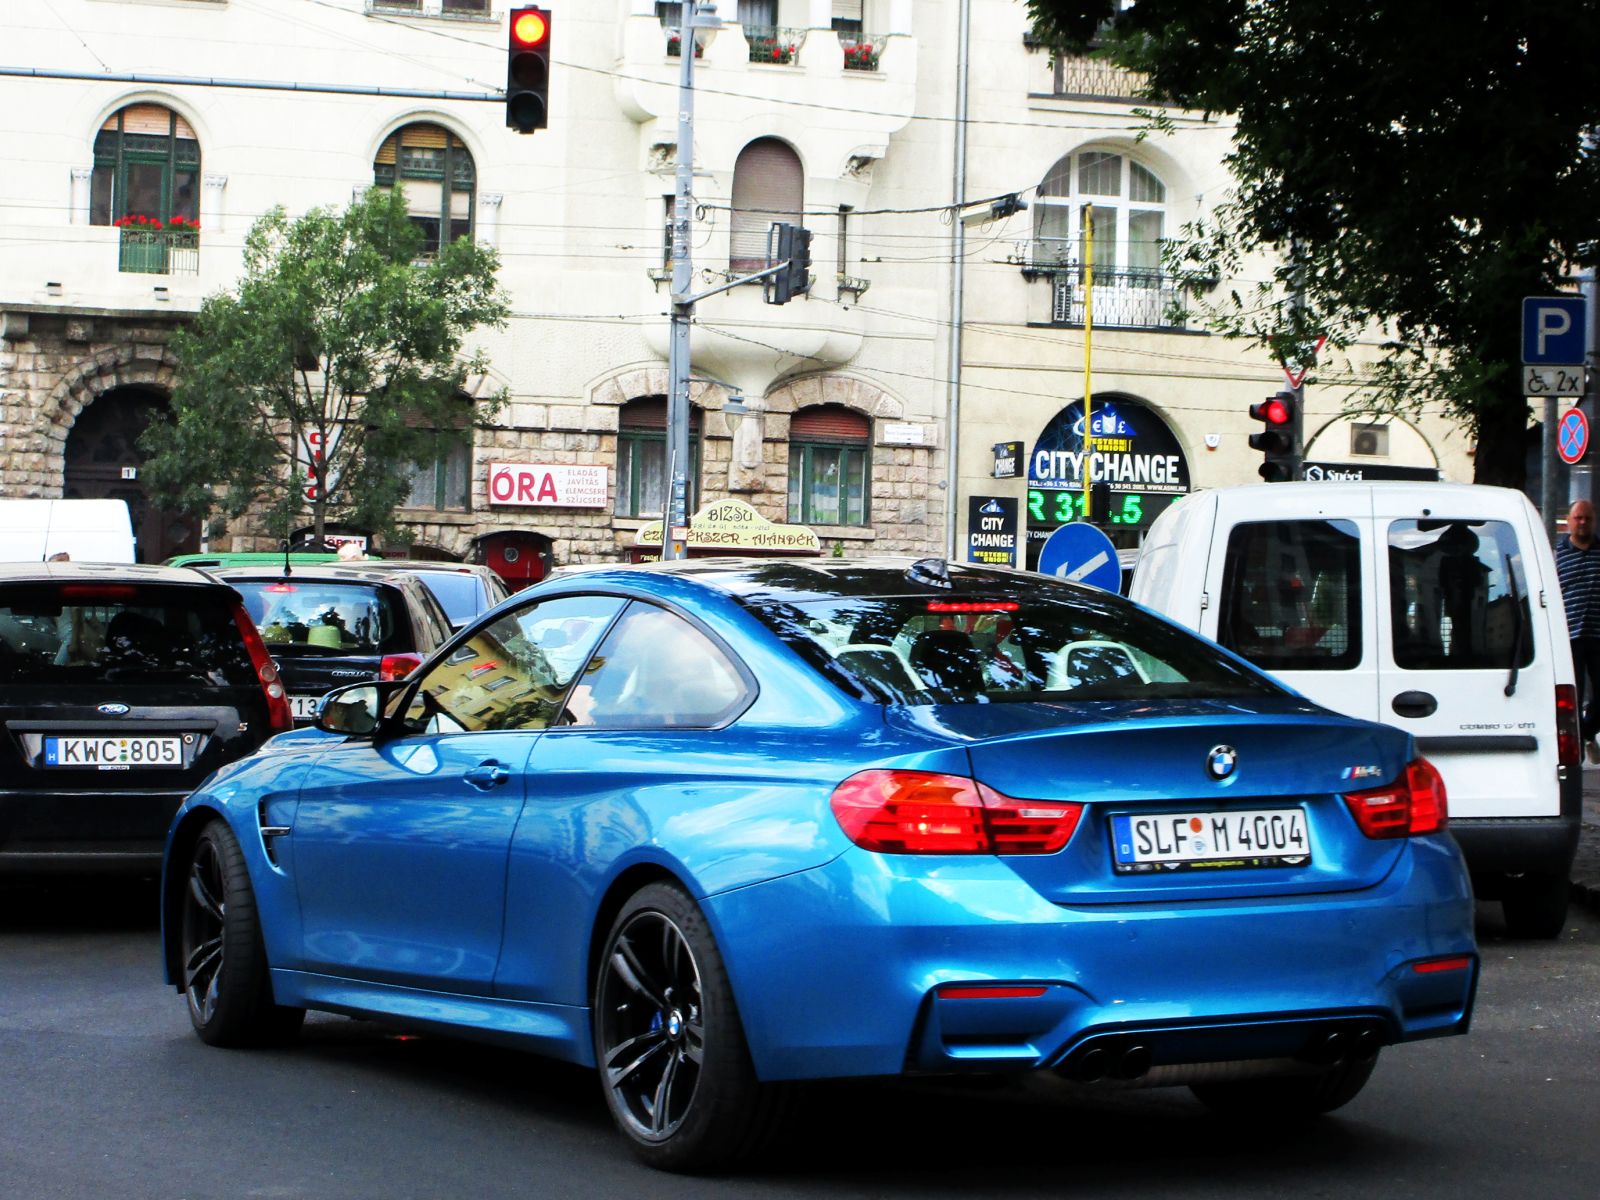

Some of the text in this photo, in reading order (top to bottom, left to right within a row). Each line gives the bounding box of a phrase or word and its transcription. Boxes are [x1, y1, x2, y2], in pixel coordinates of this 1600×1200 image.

[1537, 307, 1572, 356] P
[1090, 438, 1127, 446] ESTERN
[1035, 450, 1180, 484] CITY CHANGE
[492, 467, 558, 503] ÓRA
[971, 533, 1014, 548] CHANGE
[981, 518, 1005, 531] CITY
[1135, 819, 1188, 855] SLF
[1212, 817, 1230, 852] M
[1238, 815, 1304, 851] 4004
